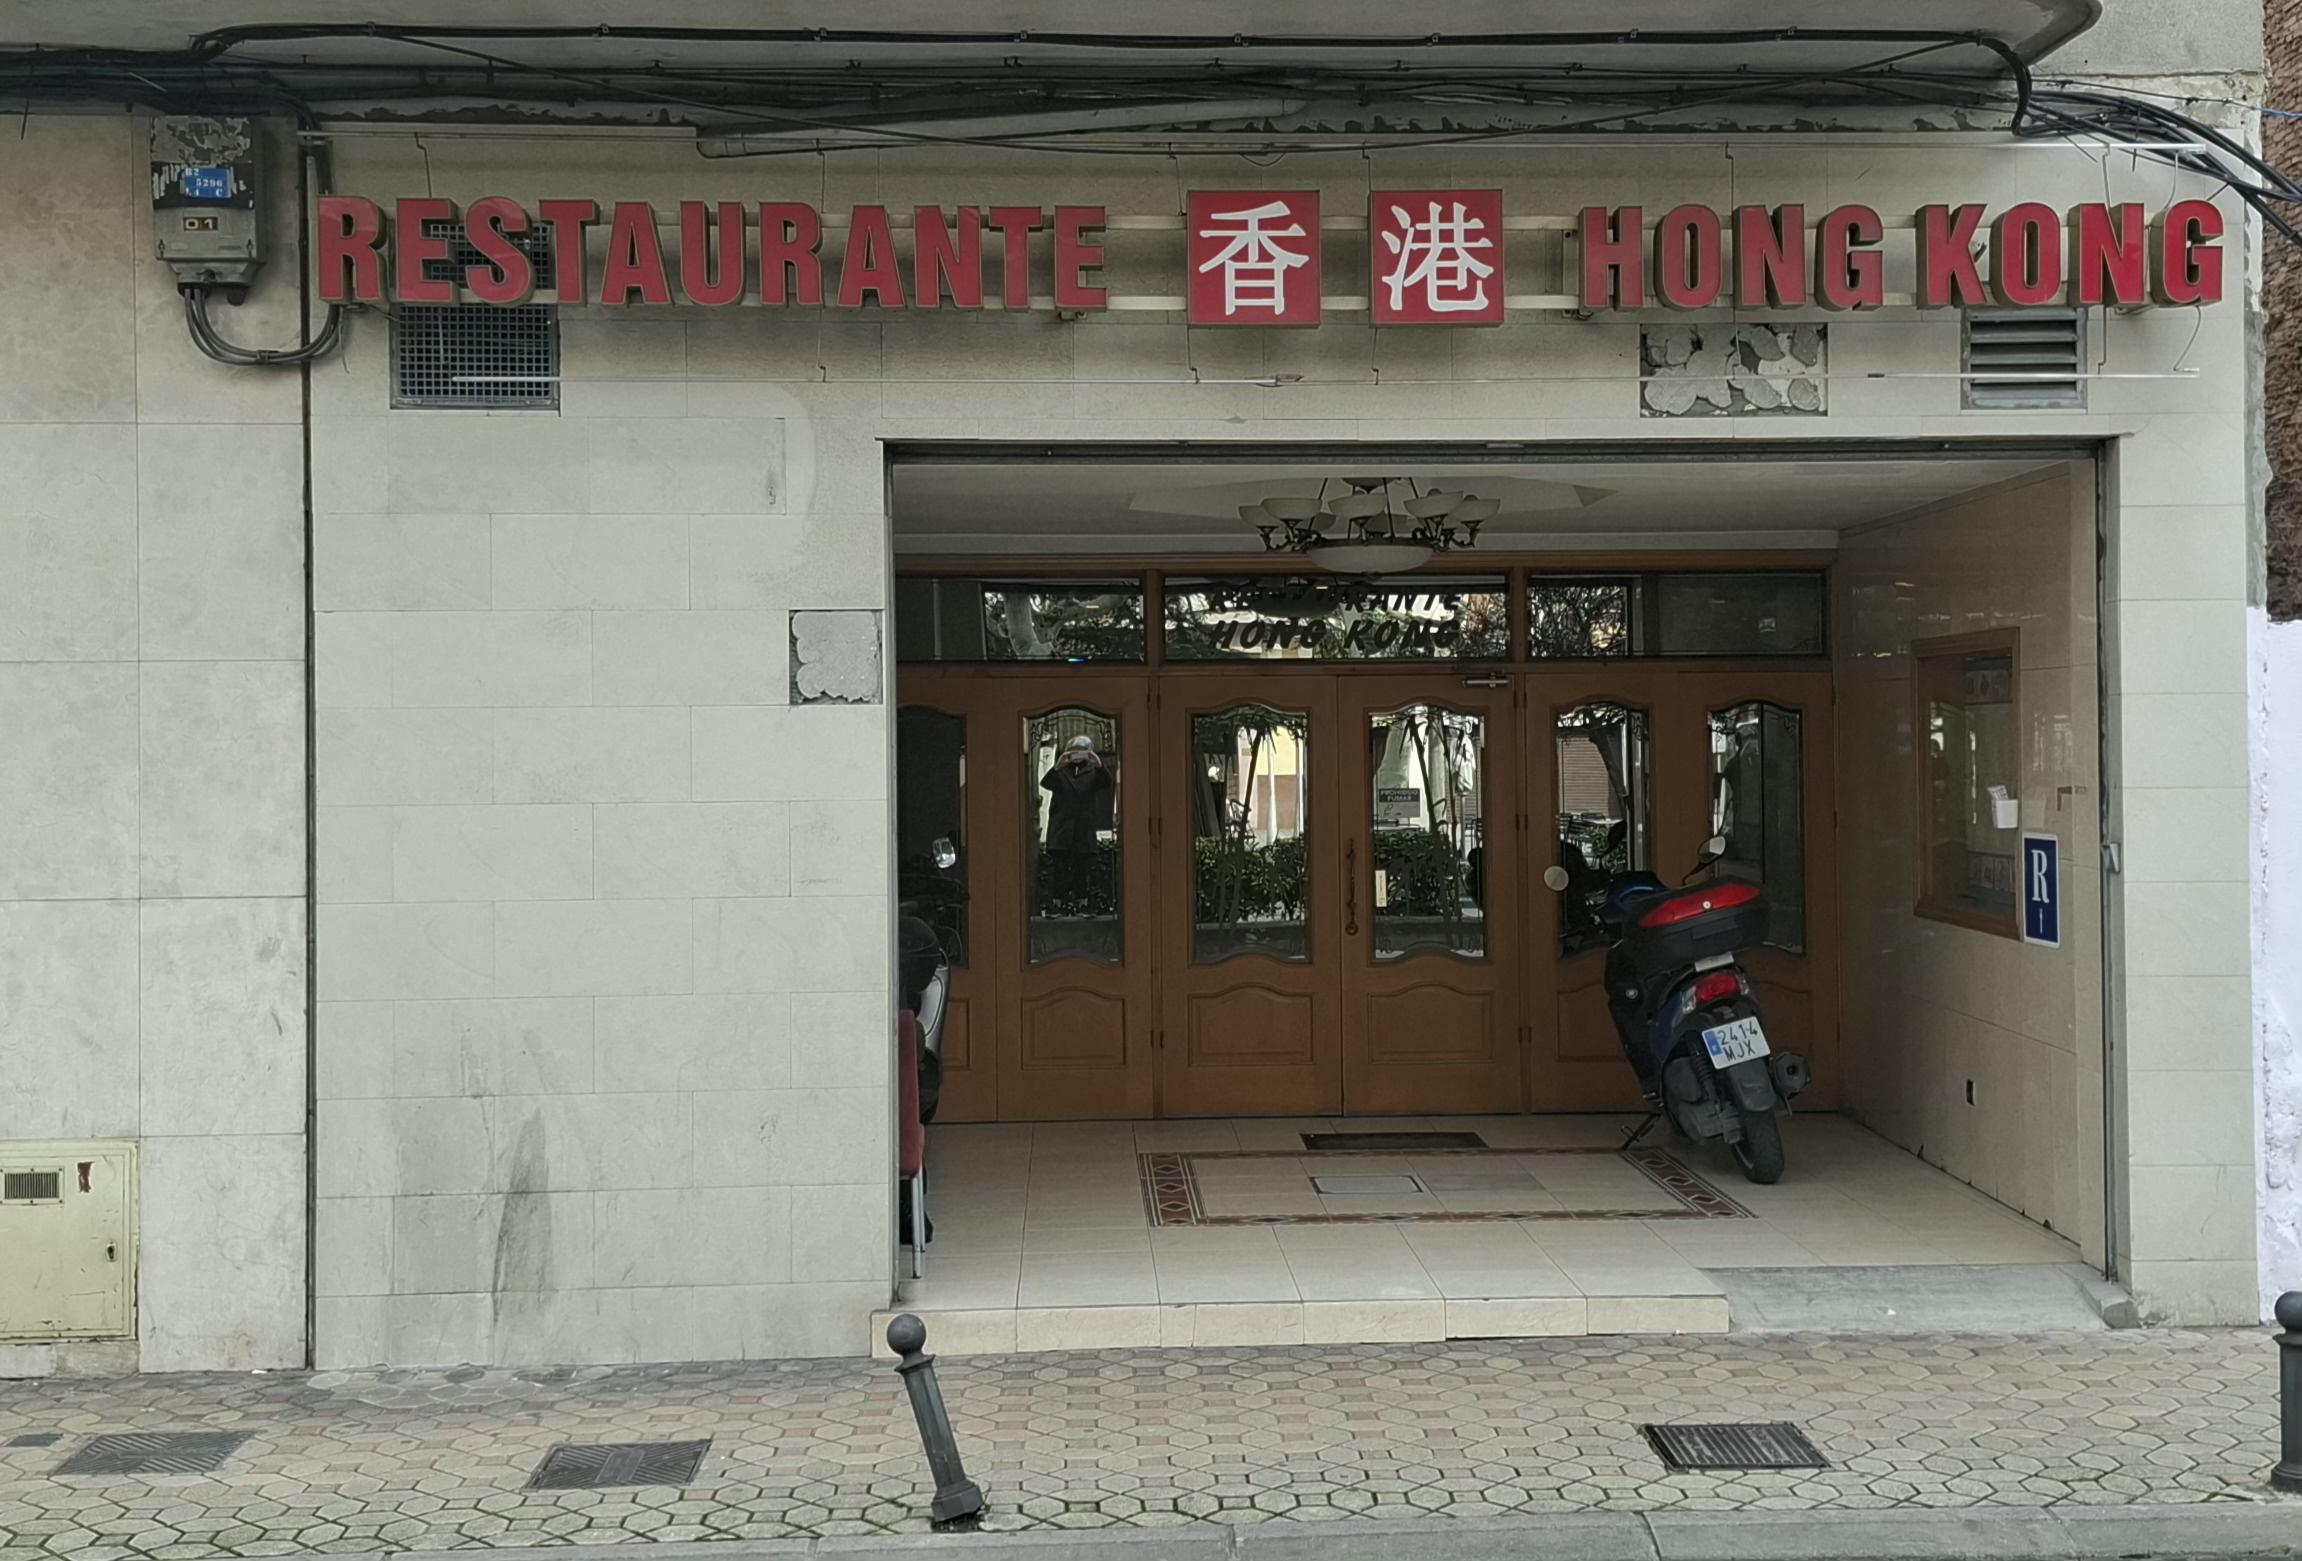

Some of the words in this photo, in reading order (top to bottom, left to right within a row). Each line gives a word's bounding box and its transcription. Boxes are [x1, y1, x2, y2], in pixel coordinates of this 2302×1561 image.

[317, 196, 1107, 311] RESTAURANTE
[1199, 200, 1495, 316] 香港
[1581, 204, 1884, 310] HONG
[1901, 199, 2224, 308] KONG
[1210, 619, 1327, 649] HONG
[1345, 619, 1461, 649] KONG
[2032, 849, 2050, 903] R
[1717, 1020, 1758, 1046] 2414
[1723, 1040, 1756, 1062] MJX
